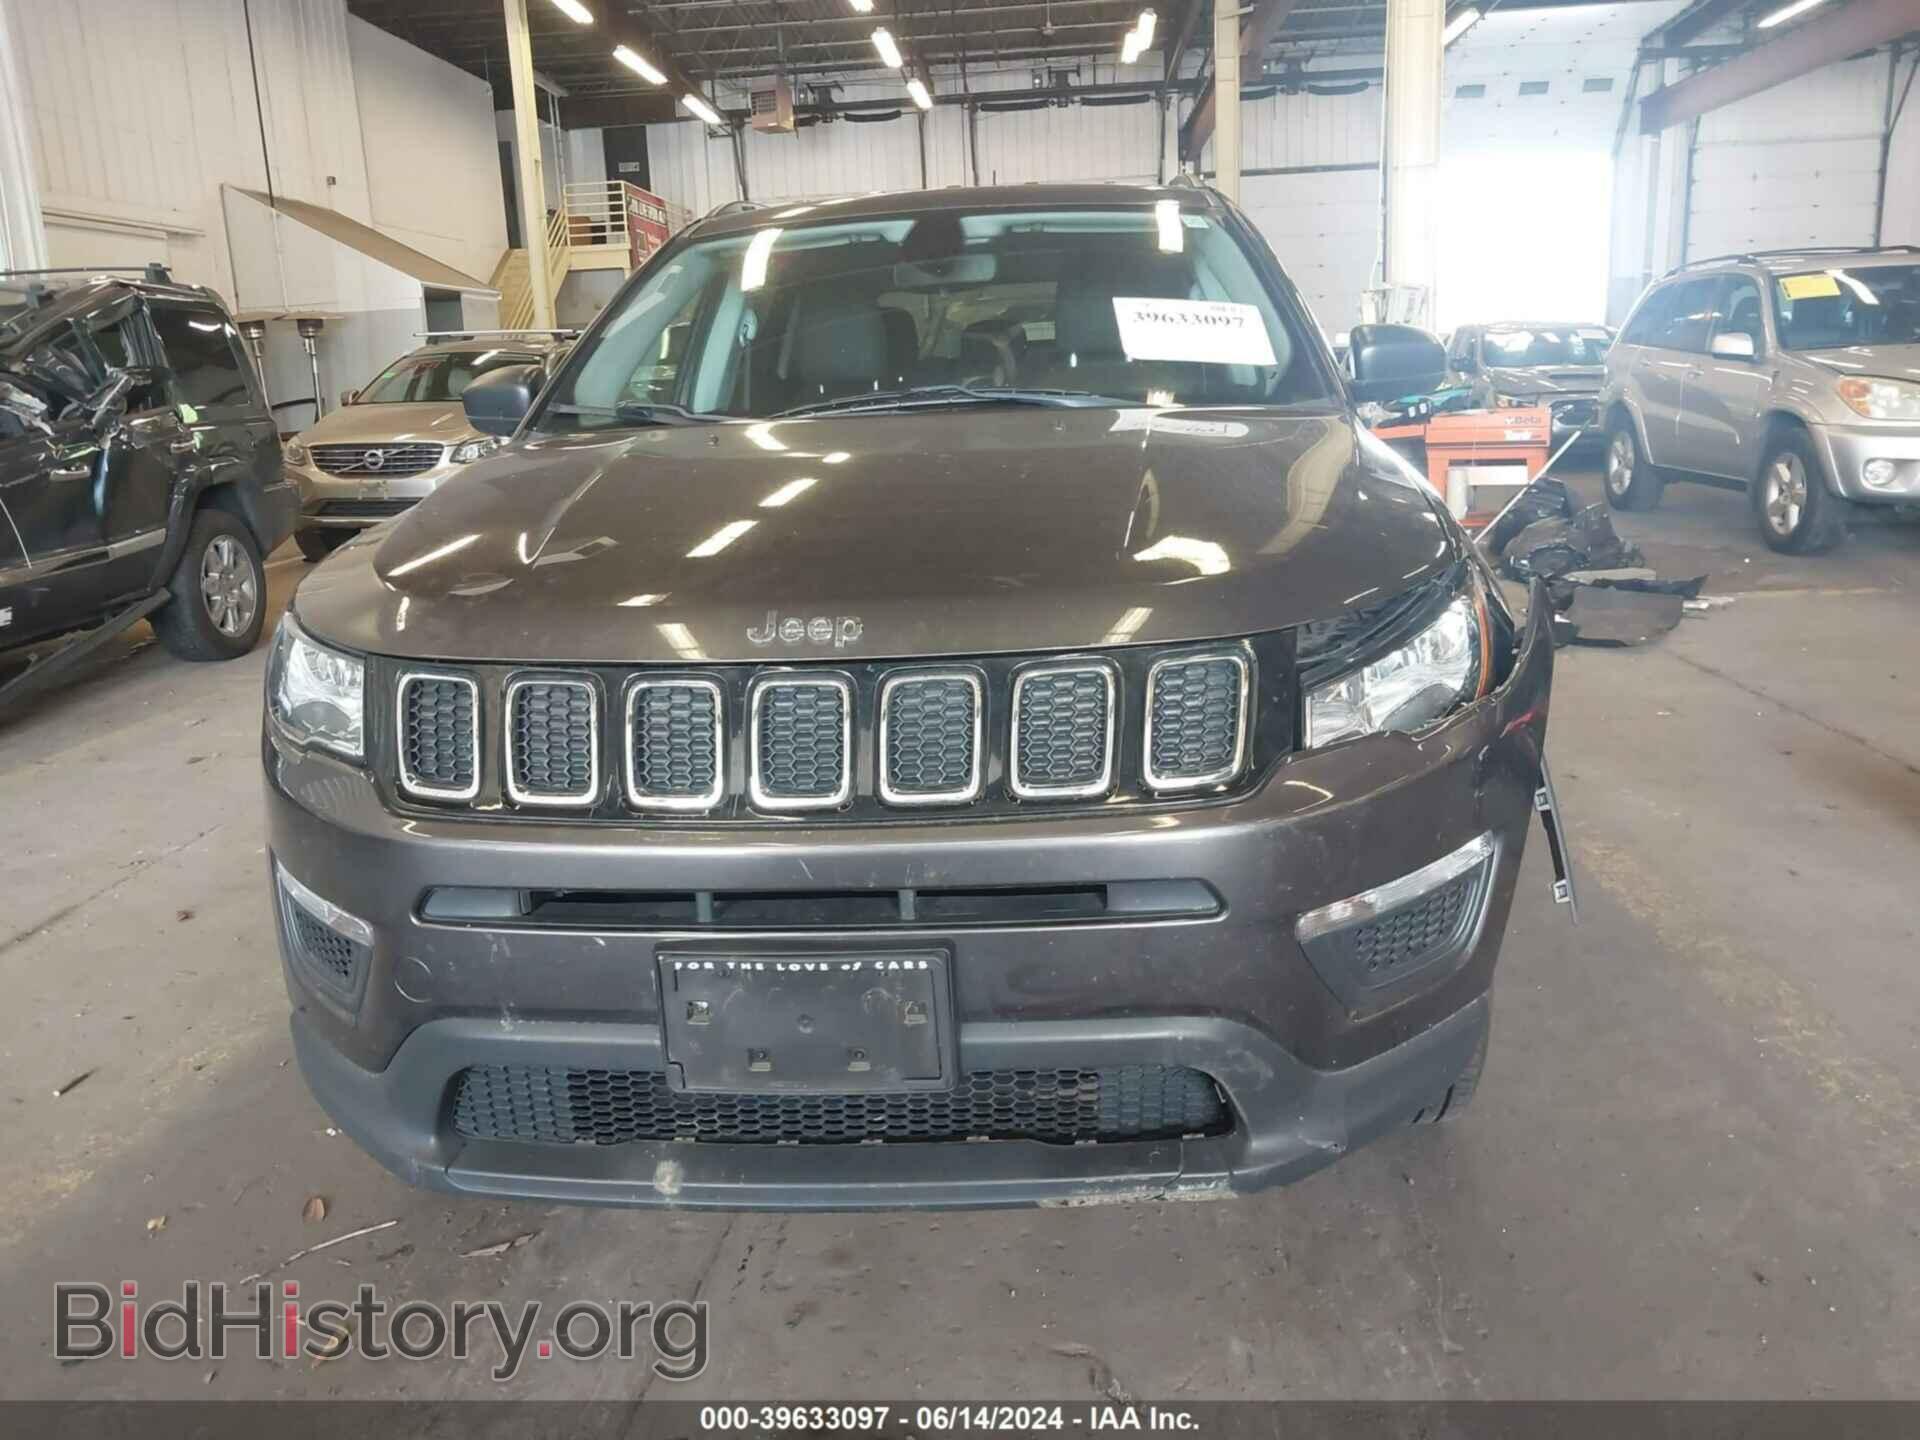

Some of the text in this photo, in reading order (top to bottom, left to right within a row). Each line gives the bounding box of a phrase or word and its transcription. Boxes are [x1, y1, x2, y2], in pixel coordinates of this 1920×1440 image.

[1133, 312, 1244, 327] 39633097
[746, 609, 865, 648] Jeep
[673, 961, 715, 971] FOR
[725, 961, 765, 971] THE
[776, 962, 830, 972] LOVE
[874, 960, 929, 970] CARS
